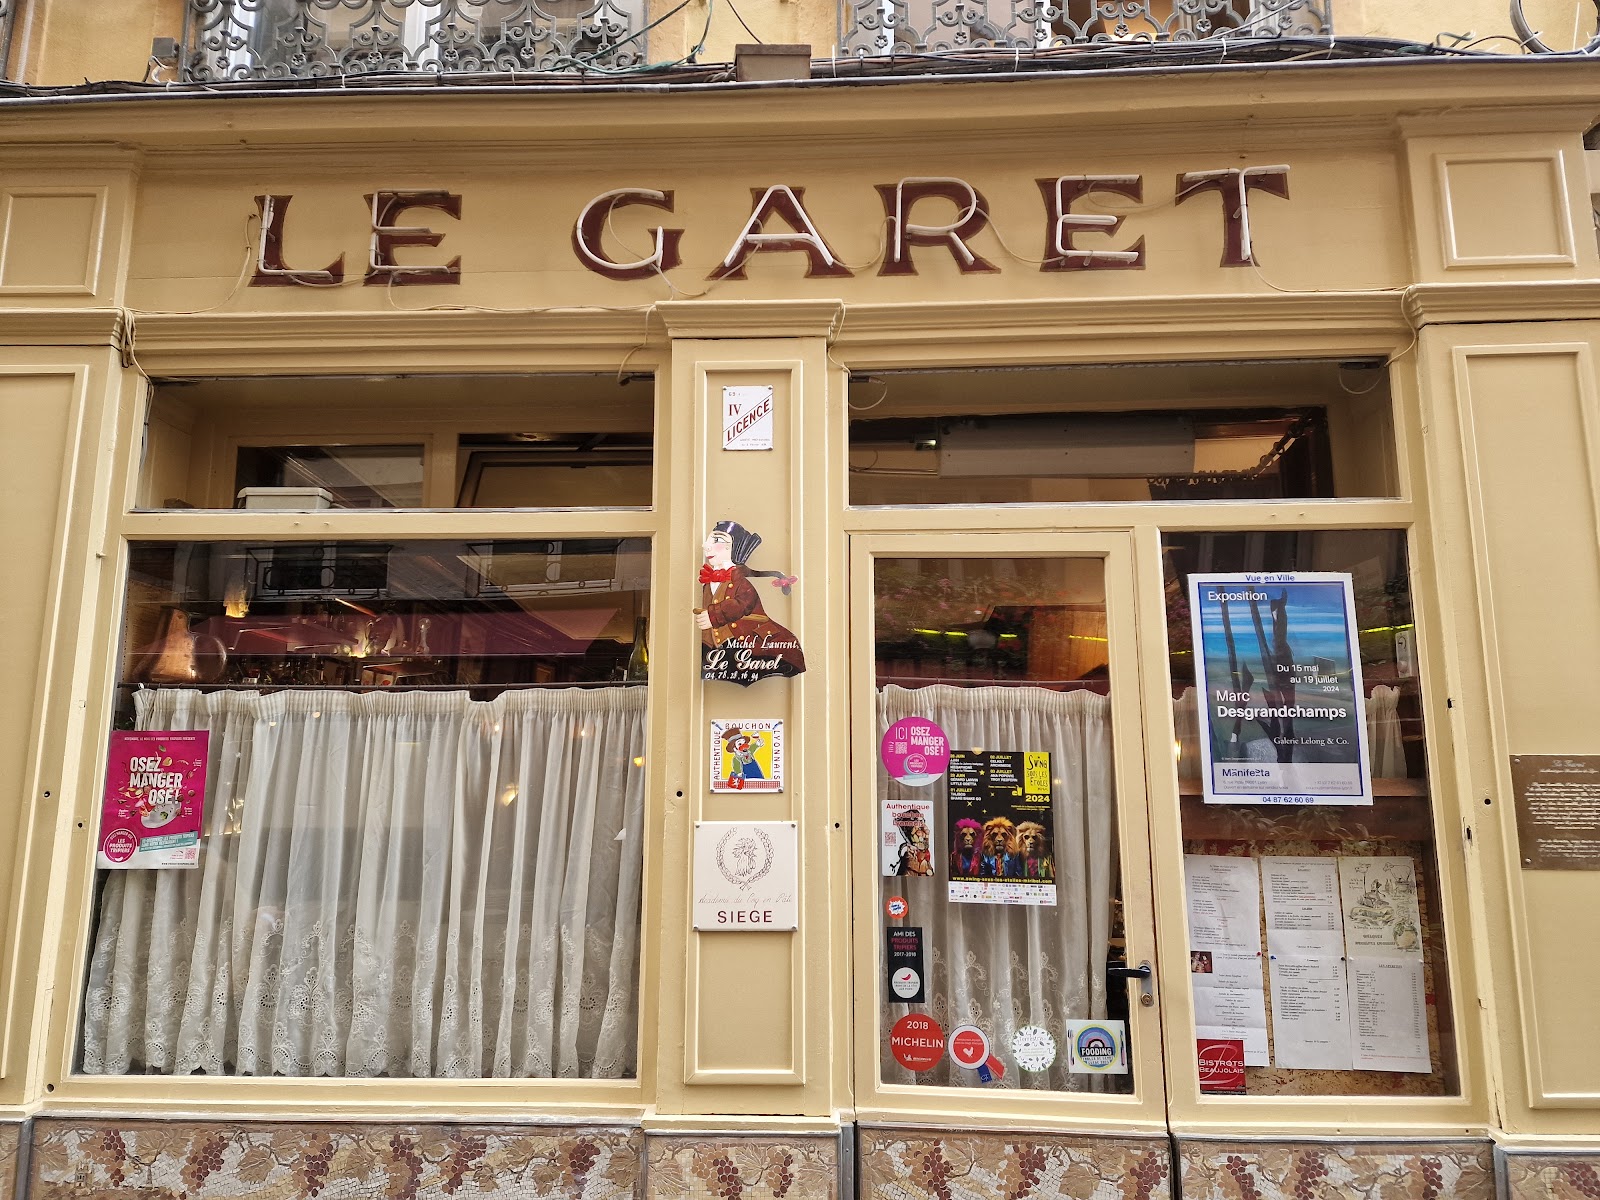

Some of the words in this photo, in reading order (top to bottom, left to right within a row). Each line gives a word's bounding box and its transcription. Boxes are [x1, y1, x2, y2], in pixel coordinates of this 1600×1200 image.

[247, 189, 463, 287] LE
[571, 165, 1292, 284] GARET
[729, 404, 742, 416] IV
[727, 398, 770, 442] LICENCE
[1208, 591, 1267, 604] Exposition
[726, 635, 758, 649] Michel
[703, 650, 729, 670] Le
[734, 650, 784, 670] Garet
[1276, 664, 1290, 673] Du
[1291, 664, 1303, 672] 15
[1304, 664, 1320, 672] mai
[1290, 676, 1302, 684] au
[1303, 675, 1315, 684] 19
[1315, 675, 1339, 685] juillet
[1216, 690, 1251, 703] Marc
[1217, 706, 1348, 723] Desgrandchamps
[725, 722, 771, 730] BOUCHON
[910, 726, 931, 737] OSEZ
[895, 727, 908, 740] ICI
[910, 736, 945, 748] MANGER
[1273, 737, 1299, 745] Galerie
[1301, 737, 1326, 747] Lelong
[1336, 737, 1350, 745] Co.
[713, 731, 721, 781] AUTHENTIQUE
[773, 730, 782, 780] LYONNAIS
[130, 756, 161, 772] OSEZ
[130, 773, 183, 789] MANGER
[1025, 795, 1050, 803] 2024
[886, 803, 931, 811] Authentique
[717, 910, 773, 924] SIEGE
[907, 1021, 929, 1030] 2018
[891, 1036, 944, 1048] MICHELIN
[1081, 1048, 1112, 1056] FOODING
[1199, 1059, 1244, 1067] BISTROTS
[1199, 1066, 1245, 1074] BEAUJOLAIS
